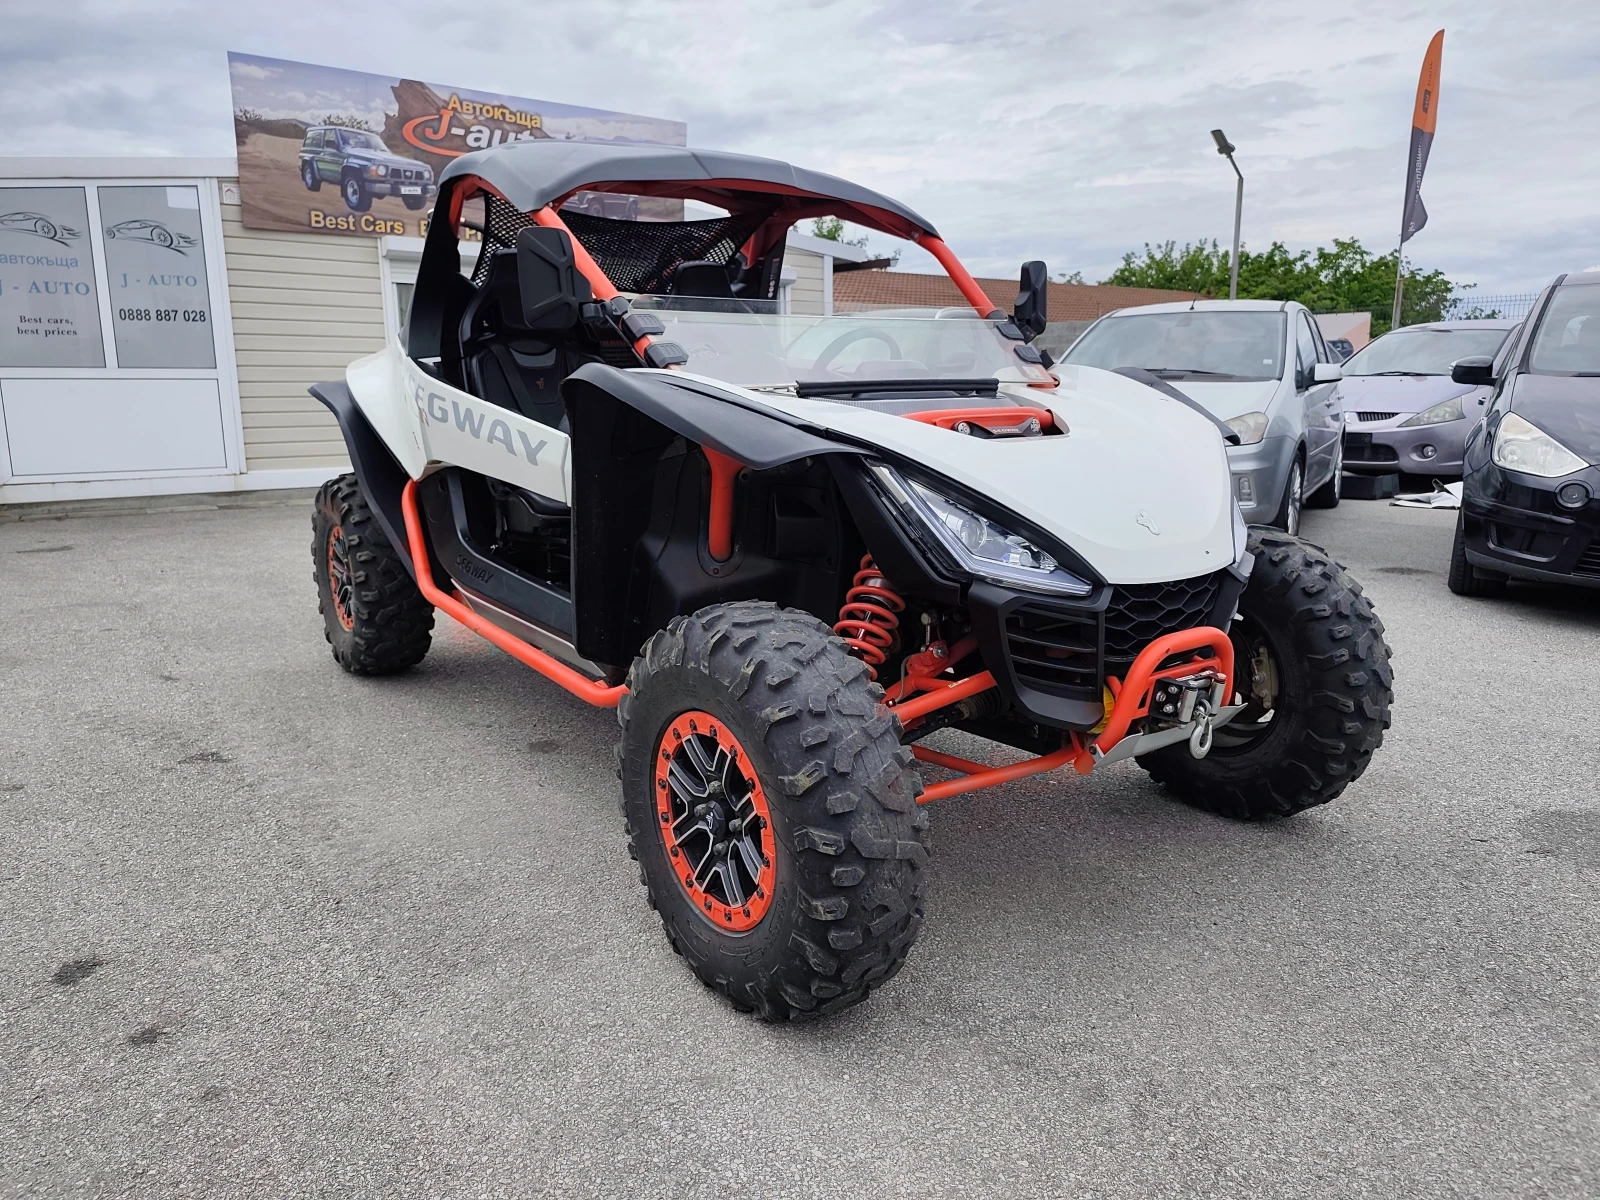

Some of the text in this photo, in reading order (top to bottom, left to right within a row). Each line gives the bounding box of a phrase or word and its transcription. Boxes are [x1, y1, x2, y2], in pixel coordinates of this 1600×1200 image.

[448, 94, 542, 128] Автокъща
[425, 109, 534, 148] J-au
[310, 211, 356, 231] Best
[361, 215, 404, 234] Cars
[0, 253, 79, 269] автокъща
[28, 280, 90, 296] AUTO
[121, 273, 128, 288] J
[148, 274, 198, 287] AUTO
[19, 315, 73, 325] Best cars,
[119, 308, 206, 322] 0888 887 028
[17, 326, 78, 338] best prices
